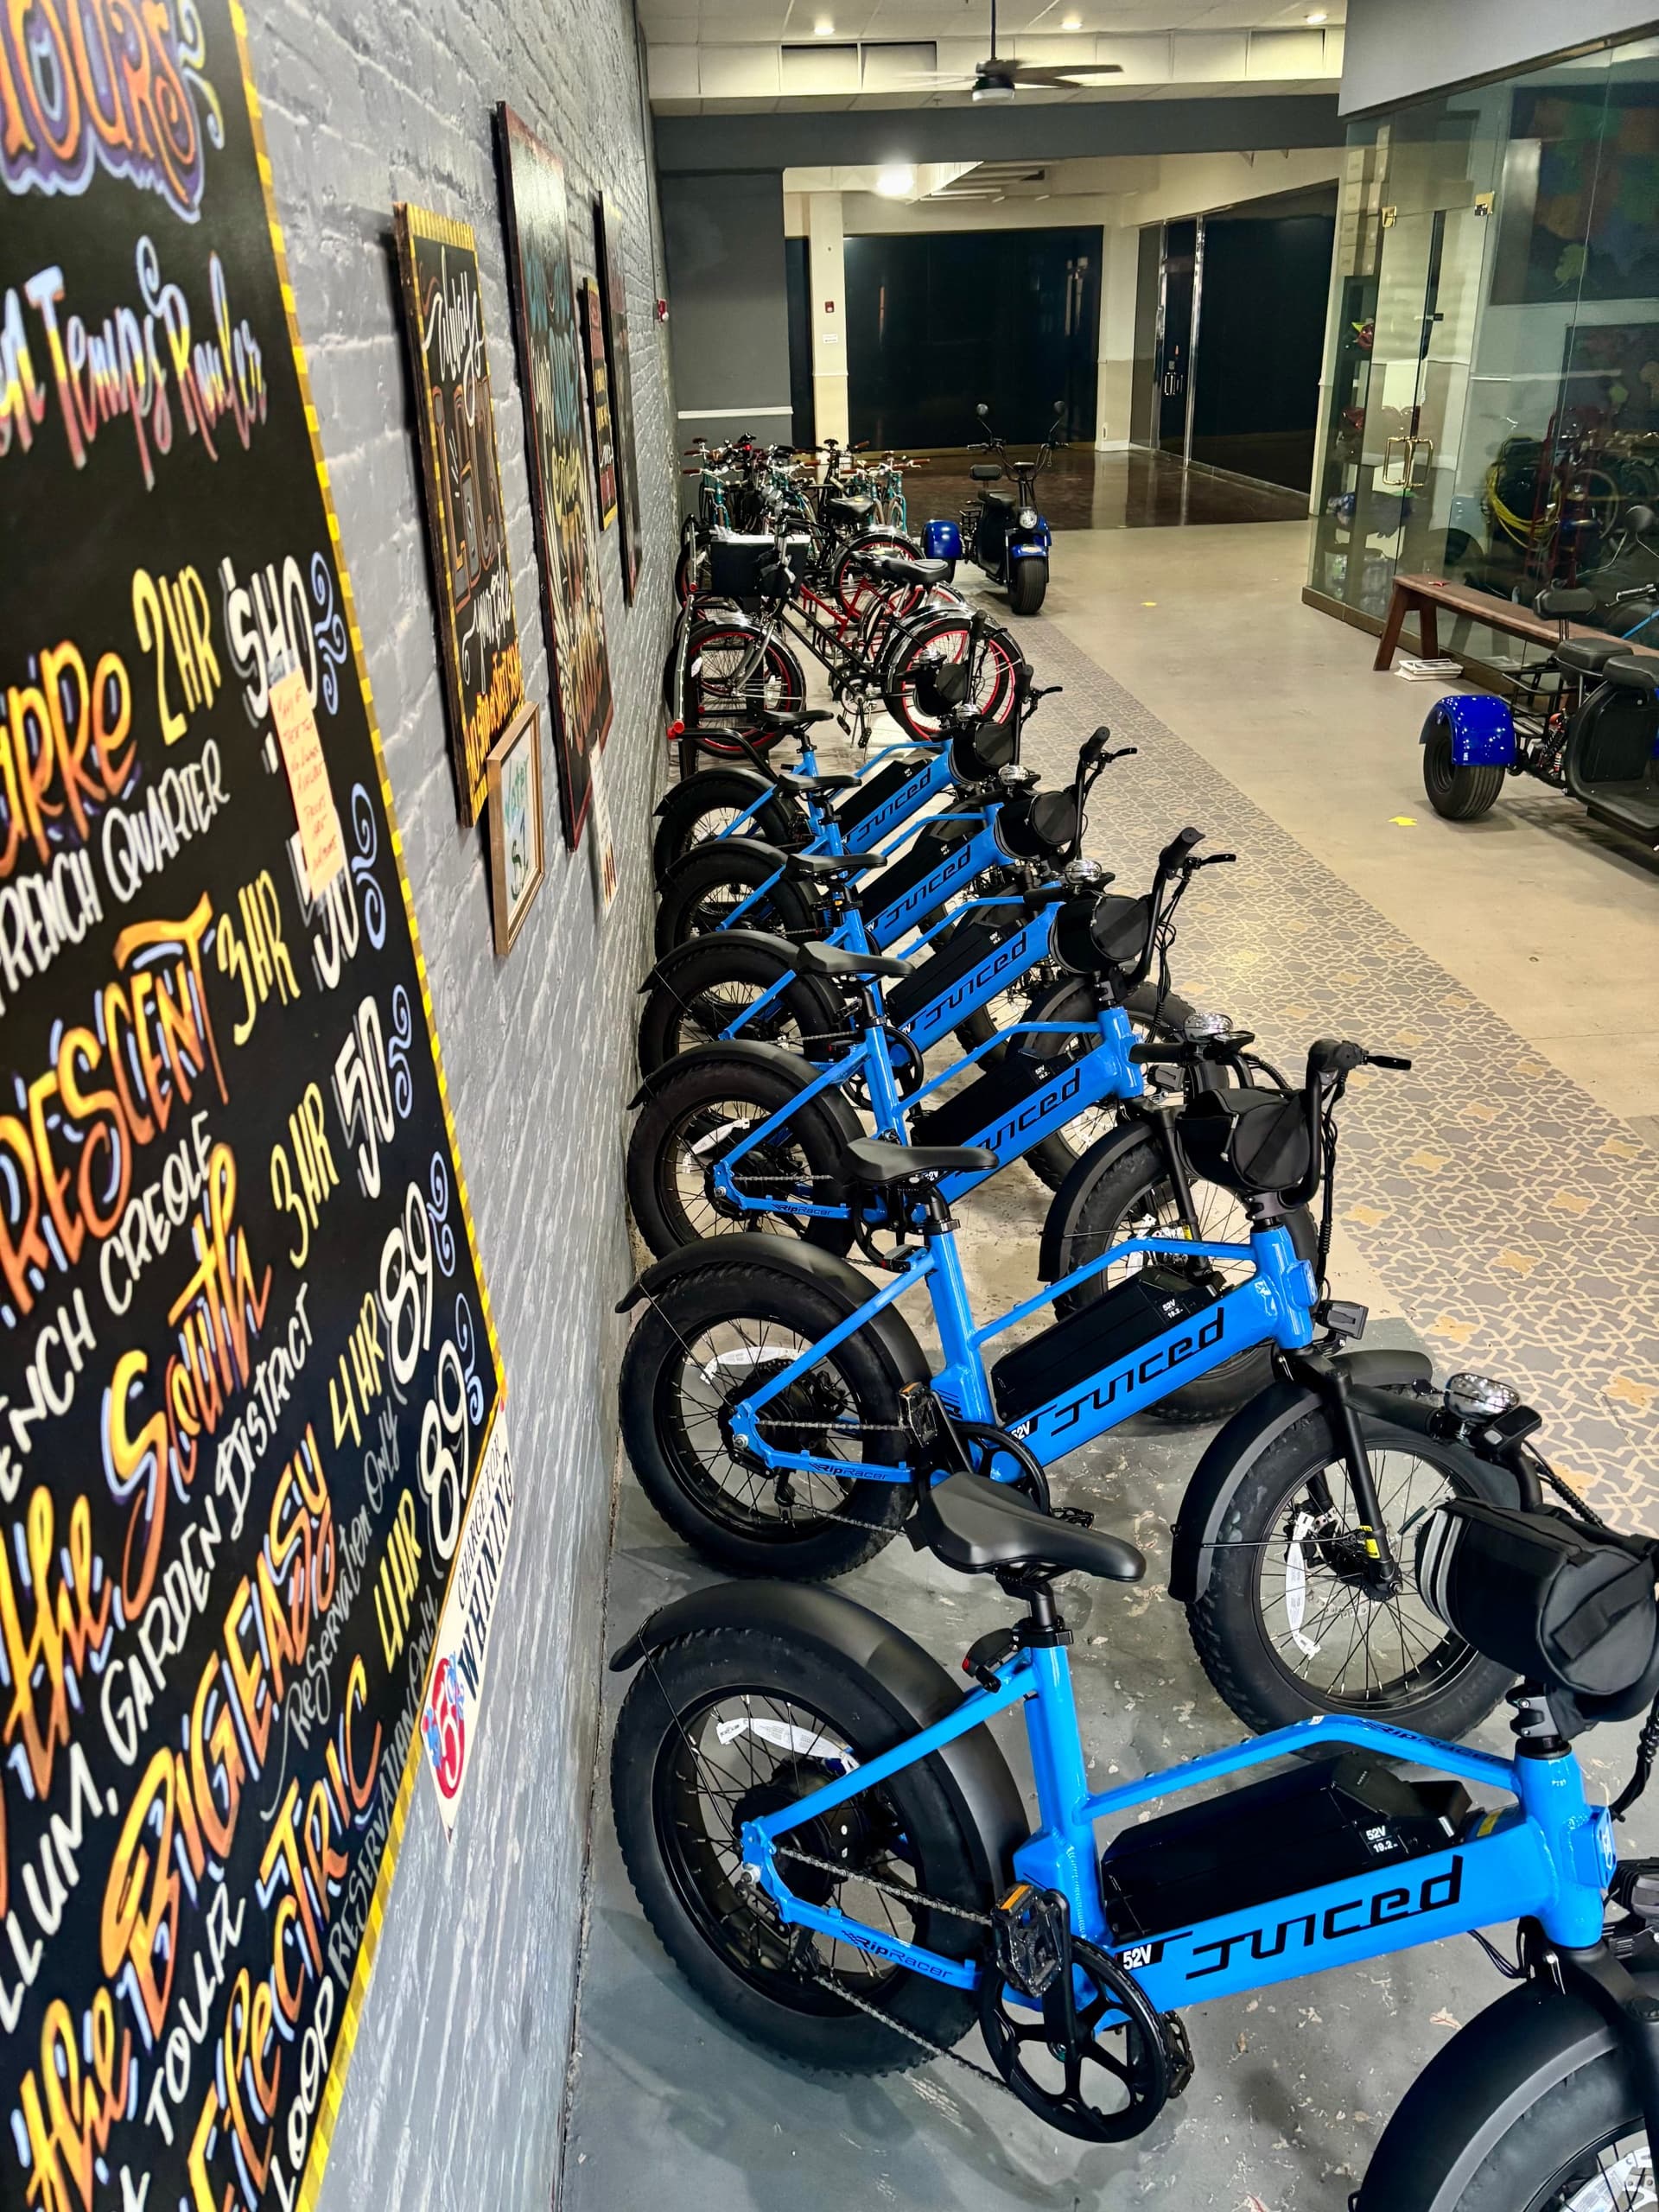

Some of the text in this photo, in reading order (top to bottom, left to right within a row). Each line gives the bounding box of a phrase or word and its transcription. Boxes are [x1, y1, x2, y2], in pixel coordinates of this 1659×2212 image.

[102, 740, 230, 902] QUARTER
[334, 995, 394, 1198] 50
[99, 1111, 212, 1315] CREOLE
[380, 1182, 432, 1383] 89
[101, 1496, 221, 1765] GARDEN
[216, 1282, 312, 1541] DISTRICT
[421, 1340, 468, 1559] 89
[457, 1438, 501, 1611] CHARGE FOR
[814, 1463, 887, 1479] RipRacer
[458, 1452, 514, 1701] WHINING
[1365, 1825, 1386, 1840] 52V
[850, 1933, 953, 1978] RipRacer
[1122, 1943, 1153, 1970] 52V
